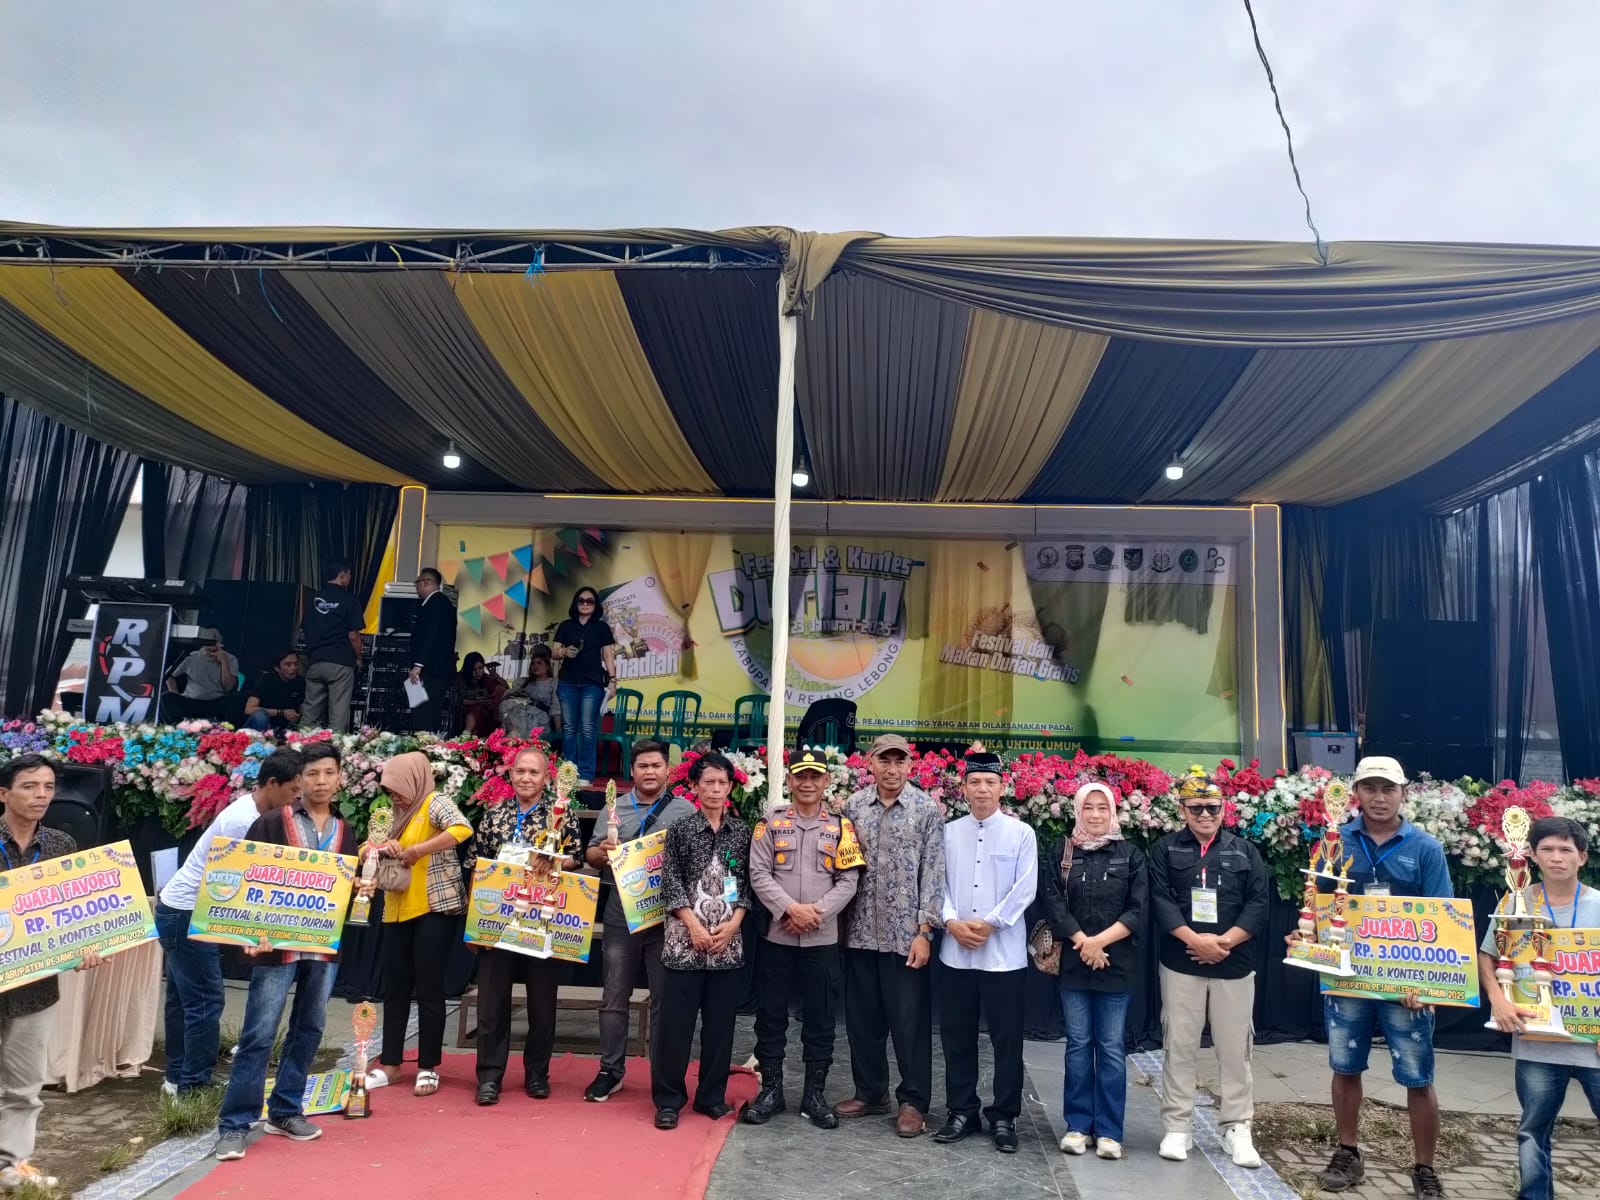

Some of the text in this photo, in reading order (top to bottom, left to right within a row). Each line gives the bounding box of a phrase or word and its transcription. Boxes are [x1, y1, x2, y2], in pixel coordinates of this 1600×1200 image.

[742, 546, 914, 577] Fesval & Kontes
[809, 619, 857, 634] Januari
[861, 620, 897, 637] 2025
[970, 631, 1055, 660] Festival dan
[732, 638, 793, 701] KABUPAN
[858, 642, 900, 692] LEBONG
[940, 645, 1081, 685] Makan Durian Gratis
[863, 718, 894, 726] REJANG
[896, 719, 930, 727] LEBONG
[932, 720, 956, 728] YANG
[956, 721, 980, 729] AKAN
[982, 722, 1046, 731] DILAKSANAKAN
[1006, 740, 1045, 751] UNTUK
[1046, 741, 1081, 752] UMUM
[645, 852, 666, 873] JUA
[244, 863, 337, 893] JUARA FAVORIT
[647, 874, 662, 889] RP
[13, 868, 120, 914] JUARA FAVORIT
[246, 887, 265, 904] RP.
[556, 892, 567, 909] 1
[635, 892, 667, 911] FESTIV
[25, 917, 51, 935] RP.
[207, 905, 336, 932] FESTIVAL & KONTES DURIAN
[1356, 916, 1418, 942] JUARA
[1420, 919, 1437, 942] 3
[47, 937, 56, 949] &
[59, 923, 101, 946] KONTES
[103, 910, 143, 932] DURIAN
[477, 918, 507, 932] FESTIV
[554, 930, 584, 944] DURIAN
[1353, 941, 1375, 958] RP.
[1351, 964, 1467, 985] TIVAL & KONTES DURIAN
[1552, 980, 1576, 997] RP.
[1581, 1005, 1590, 1018] &
